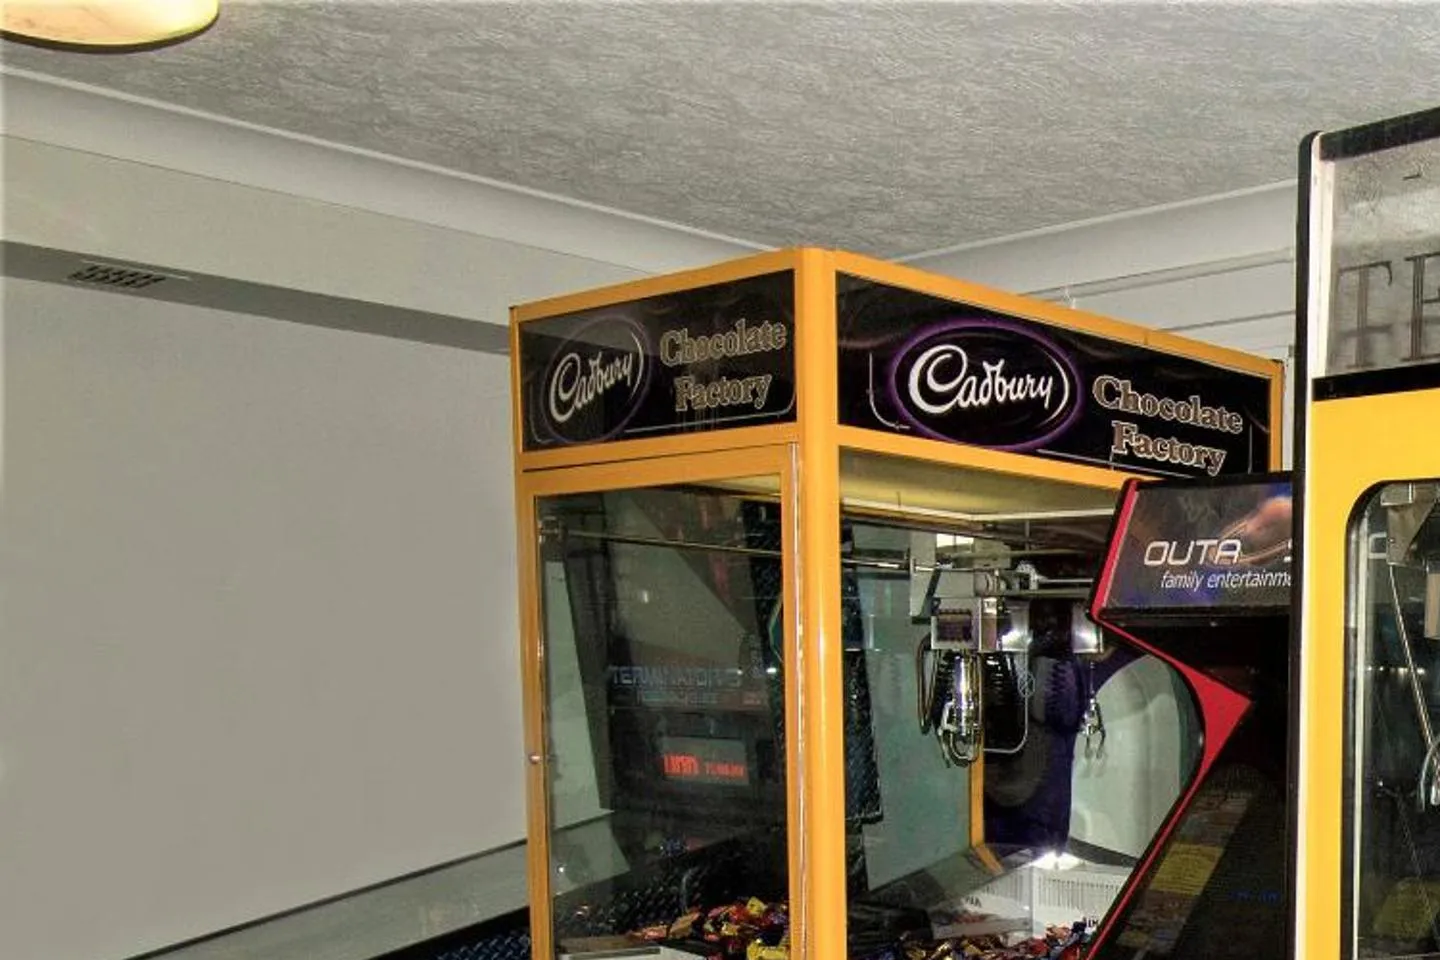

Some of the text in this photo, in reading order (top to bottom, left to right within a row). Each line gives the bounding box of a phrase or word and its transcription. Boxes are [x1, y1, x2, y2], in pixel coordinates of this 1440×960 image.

[660, 318, 788, 367] Chocolate
[550, 351, 634, 422] Cadbury
[674, 374, 773, 412] Factory
[908, 344, 1053, 414] Cadbury
[1092, 374, 1244, 435] Chocolate
[1111, 420, 1228, 477] Factory
[1144, 539, 1242, 567] OUTA
[1160, 570, 1204, 592] family
